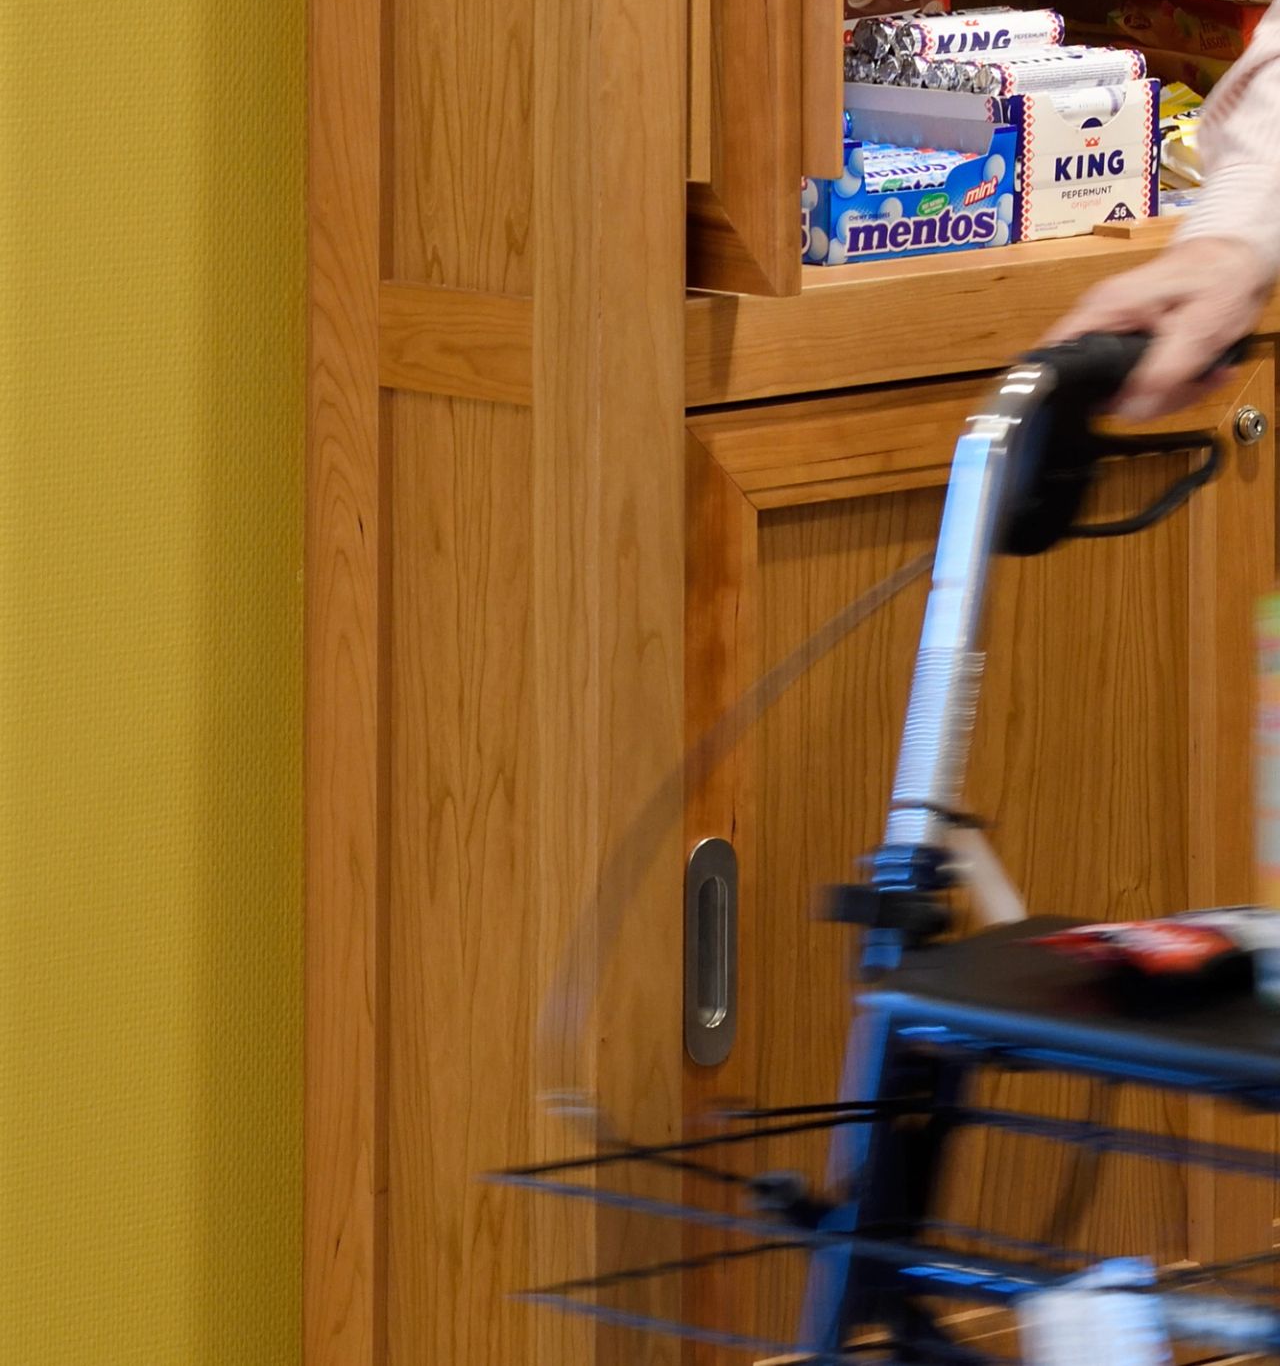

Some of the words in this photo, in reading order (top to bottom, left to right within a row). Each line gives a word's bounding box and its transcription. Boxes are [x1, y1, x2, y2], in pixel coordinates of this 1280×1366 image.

[935, 29, 1011, 55] KING
[1013, 31, 1048, 40] PEPERMUNT
[1054, 149, 1126, 182] KING
[963, 176, 998, 206] mint
[1061, 185, 1113, 200] PEPERMUNT
[1114, 205, 1127, 217] 36
[847, 208, 996, 253] mentos
